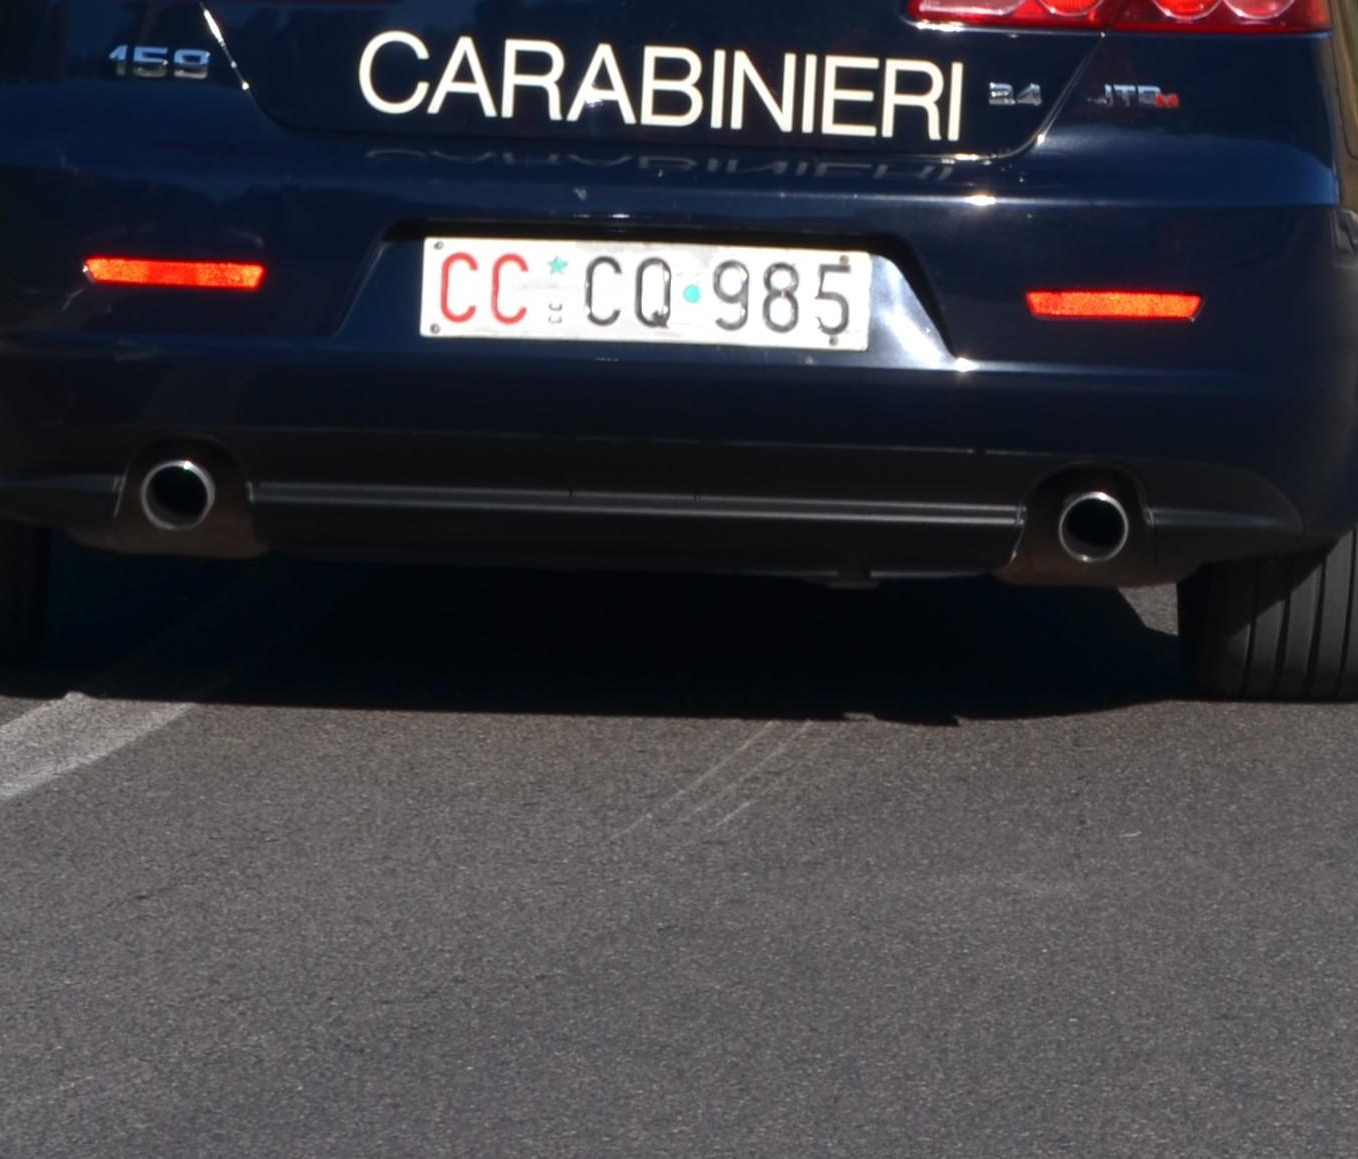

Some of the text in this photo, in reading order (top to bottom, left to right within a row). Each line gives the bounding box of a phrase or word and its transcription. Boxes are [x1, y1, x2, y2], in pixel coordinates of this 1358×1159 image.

[108, 45, 211, 79] 159
[359, 30, 964, 141] CARABINIERI
[441, 252, 852, 335] CC CQ 985
